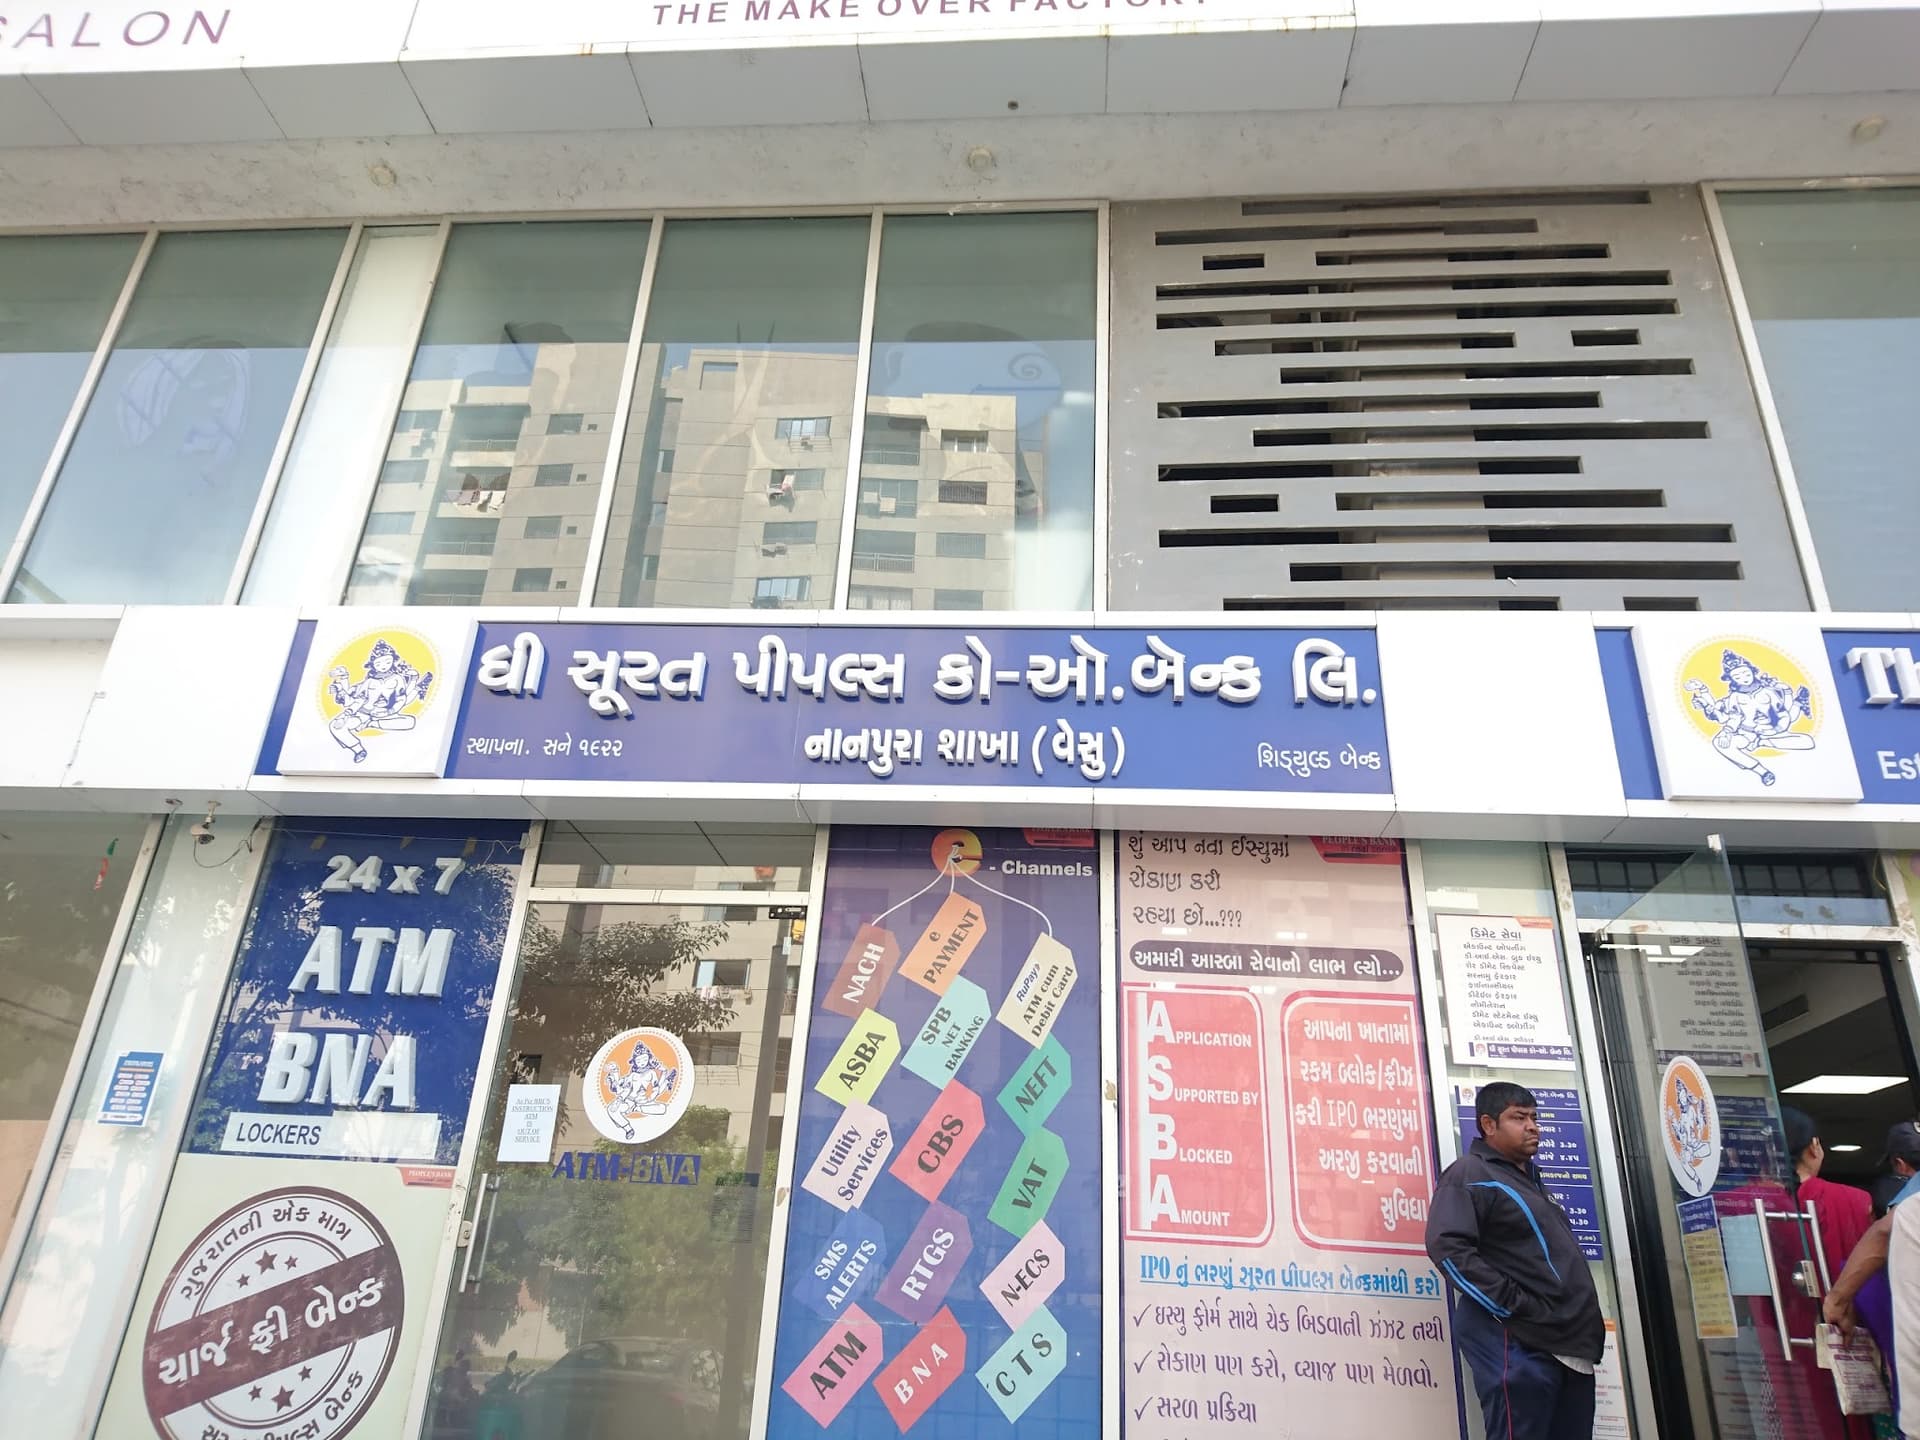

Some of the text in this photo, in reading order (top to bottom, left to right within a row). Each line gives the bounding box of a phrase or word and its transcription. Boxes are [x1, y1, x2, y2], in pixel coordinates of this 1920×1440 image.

[0, 9, 231, 48] ALON
[653, 2, 728, 25] THE
[744, 0, 859, 21] MAKE
[877, 0, 991, 16] OVER
[478, 632, 545, 695] ધી
[568, 650, 706, 717] સૂરત
[733, 635, 905, 699] પીપલ્સ
[1292, 638, 1377, 704] લિ.
[543, 732, 572, 756] સને
[579, 739, 623, 756] ૧૯૨૨
[804, 718, 1126, 781] નાનપુરા શાખા (વેસુ)
[1340, 743, 1381, 770] બેન્ક
[1128, 830, 1144, 860] શું
[1152, 838, 1187, 854] આપ
[1194, 839, 1223, 855] નવા
[321, 855, 466, 896] 24 x 7
[1002, 860, 1093, 877] Channels
[1128, 864, 1221, 892] રોકાણ કરી
[923, 908, 980, 984] PAYMENT
[1501, 928, 1521, 939] સેવા
[287, 925, 456, 998] ATM
[842, 943, 885, 1003] NACH
[1016, 965, 1039, 1002] RuPay
[1134, 947, 1184, 968] અમારી
[1191, 955, 1243, 971] આસ્બા
[1250, 949, 1301, 973] સેવાનો
[1308, 957, 1345, 975] લાભ
[1022, 964, 1060, 1025] ATM cum
[1031, 966, 1074, 1038] Debit Card
[921, 1006, 953, 1046] SPB
[941, 1022, 962, 1048] NET
[944, 1015, 985, 1072] BANKING
[1303, 1013, 1410, 1045] આપના ખાતામાં
[257, 1031, 417, 1108] BNA
[838, 1031, 887, 1091] ASBA
[1300, 1060, 1332, 1083] રકમ
[1015, 1056, 1058, 1113] NEFT
[1242, 1091, 1259, 1106] BY
[236, 1122, 321, 1146] LOCKERS
[1295, 1096, 1322, 1126] કરી
[1326, 1100, 1358, 1128] IPO
[821, 1125, 863, 1178] Utility
[837, 1128, 888, 1201] Services
[917, 1114, 965, 1174] CBS
[1319, 1145, 1423, 1180] અરજી કરવાની
[552, 1151, 702, 1185] ATM-BNA
[1011, 1158, 1048, 1210] VAT
[1380, 1187, 1428, 1232] સુવિધા
[180, 1200, 352, 1299] ગુજરાતની એક માત્ર
[814, 1239, 849, 1281] SMS
[900, 1228, 955, 1301] RTGS
[824, 1239, 878, 1310] ALERTS
[1000, 1248, 1051, 1307] N-ECS
[1140, 1255, 1171, 1280] IPO
[1176, 1255, 1189, 1288] નું
[1194, 1257, 1234, 1289] ભરણું
[1281, 1261, 1334, 1290] પીપલ્સ
[1340, 1264, 1409, 1294] બેન્કમાંથી
[1415, 1269, 1441, 1296] કરો
[304, 1277, 384, 1328] બેન્ક
[1193, 1296, 1221, 1332] ફોર્મ
[1228, 1302, 1258, 1330] સાથે
[1266, 1303, 1289, 1332] ચેક
[1297, 1304, 1362, 1337] બિડવાની
[1413, 1315, 1445, 1342] નથી
[809, 1330, 868, 1401] ATM
[1157, 1342, 1438, 1388] રોકાણ પણ કરો, વ્યાજ પણ મેળવો.
[324, 1370, 363, 1421] બેન્ક
[1157, 1397, 1198, 1420] સરળ
